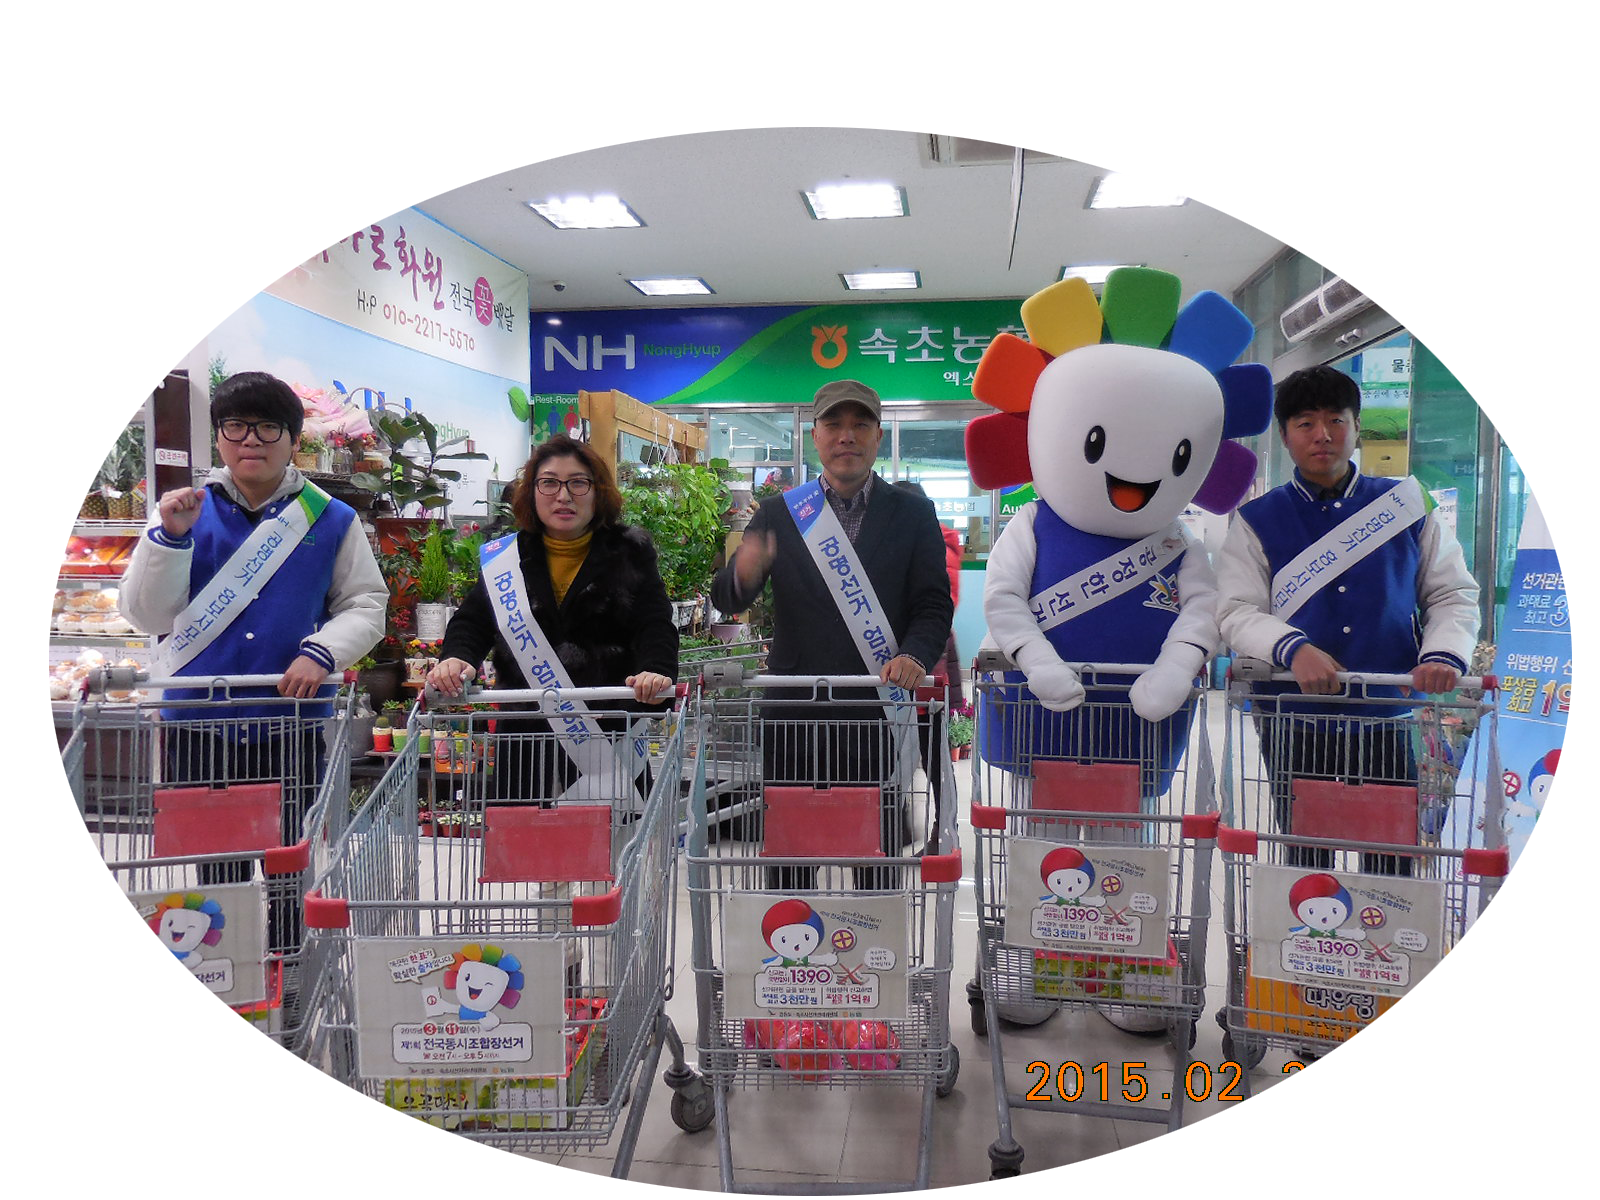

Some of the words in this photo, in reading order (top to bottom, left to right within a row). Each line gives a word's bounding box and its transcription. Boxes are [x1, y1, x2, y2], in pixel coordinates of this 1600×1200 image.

[449, 281, 475, 316] 전국
[475, 281, 493, 323] 꽃
[383, 303, 476, 352] 010-2217-5570
[544, 334, 635, 371] NH
[643, 343, 721, 358] NongHyup
[858, 325, 1031, 364] 속초농
[534, 395, 579, 405] Rest-Room
[1389, 492, 1405, 508] NH
[1338, 509, 1396, 552] 공명선거
[235, 531, 283, 587] 공명선거
[1080, 545, 1158, 599] 공정한
[818, 535, 873, 616] 공명선거
[494, 570, 538, 652] 공명선거
[1524, 609, 1548, 624] 최고
[1506, 653, 1558, 674] 위법행위
[1516, 875, 1569, 912] 1390
[1063, 907, 1099, 921] 1390
[1317, 940, 1358, 957] 1390
[129, 970, 226, 992] 전국동시조합장선거
[790, 969, 831, 983] 1390
[400, 1040, 421, 1050] 제1회
[423, 1037, 524, 1050] 전국동시조합장선거
